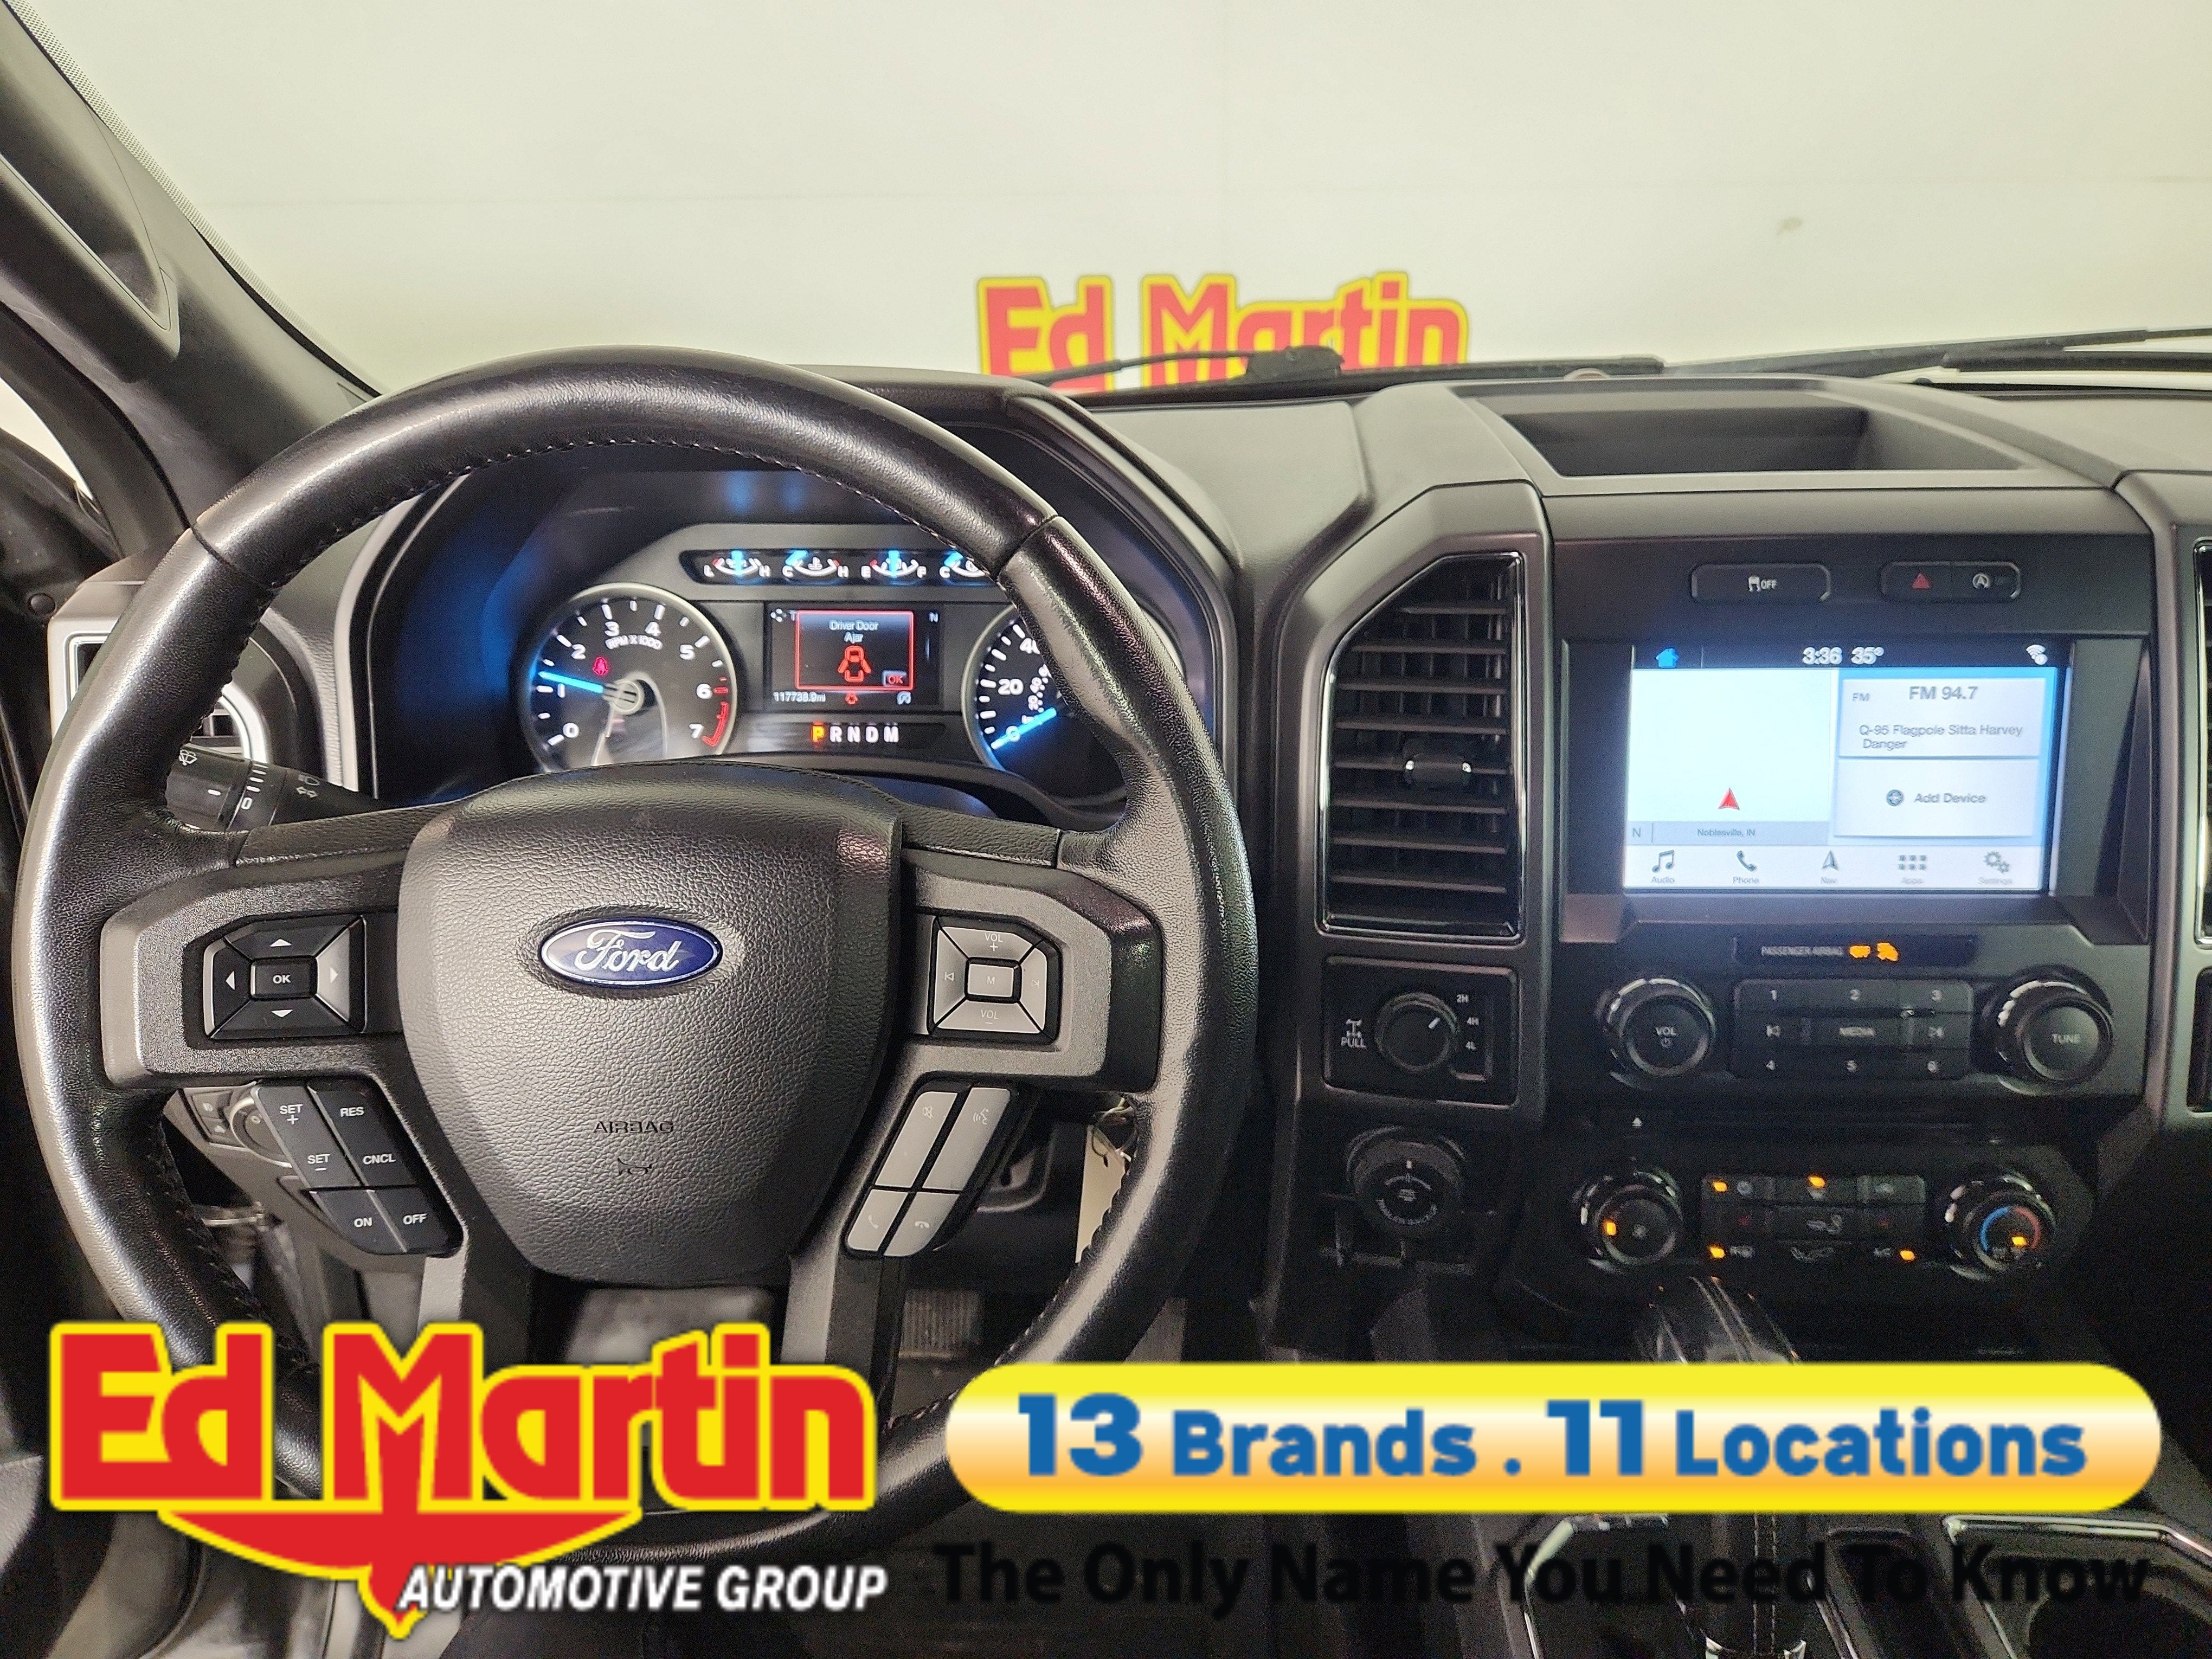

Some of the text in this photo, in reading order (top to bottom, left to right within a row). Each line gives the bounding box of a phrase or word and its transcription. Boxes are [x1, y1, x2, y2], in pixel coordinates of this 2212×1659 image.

[977, 271, 1467, 393] Ed Martin
[605, 621, 619, 636] 3
[645, 621, 660, 636] 4
[829, 620, 879, 631] Driver Door
[844, 632, 864, 644] Ajar
[571, 644, 586, 659] 2
[679, 644, 695, 660] 5
[1802, 647, 1843, 665] 3:36
[888, 676, 904, 684] OK
[696, 683, 712, 699] 6
[998, 678, 1024, 696] 20
[1908, 685, 1979, 700] FM 94.7
[1852, 693, 1870, 702] FM
[562, 722, 579, 738] 0
[689, 723, 704, 738] 7
[811, 725, 899, 743] P R N D M
[1859, 724, 2023, 738] Q-95 Flagpole Sitta Harvey
[1863, 738, 1907, 751] Danger
[1913, 793, 1986, 803] Add Device
[1631, 827, 1642, 838] N
[1697, 828, 1756, 838] Noblesville, IN
[1651, 876, 1676, 884] Audio
[1732, 876, 1760, 885] Phone
[1821, 876, 1837, 884] Nav
[984, 933, 1004, 943] VOL
[573, 928, 683, 972] Ford
[272, 974, 291, 985] OK
[1456, 994, 1470, 1004] 2H
[980, 1009, 1000, 1020] VOL
[1467, 1017, 1480, 1027] 4H
[1655, 1026, 1678, 1038] VOL
[1341, 1036, 1367, 1049] PULL
[2051, 1033, 2081, 1045] TUNE
[1465, 1041, 1478, 1051] 4L
[279, 1103, 303, 1115] SET
[340, 1106, 365, 1117] RES
[593, 1120, 675, 1134] AIRBAG
[307, 1153, 331, 1165] SET
[363, 1153, 397, 1165] CNCL
[353, 1217, 373, 1228] ON
[402, 1213, 428, 1225] OFF
